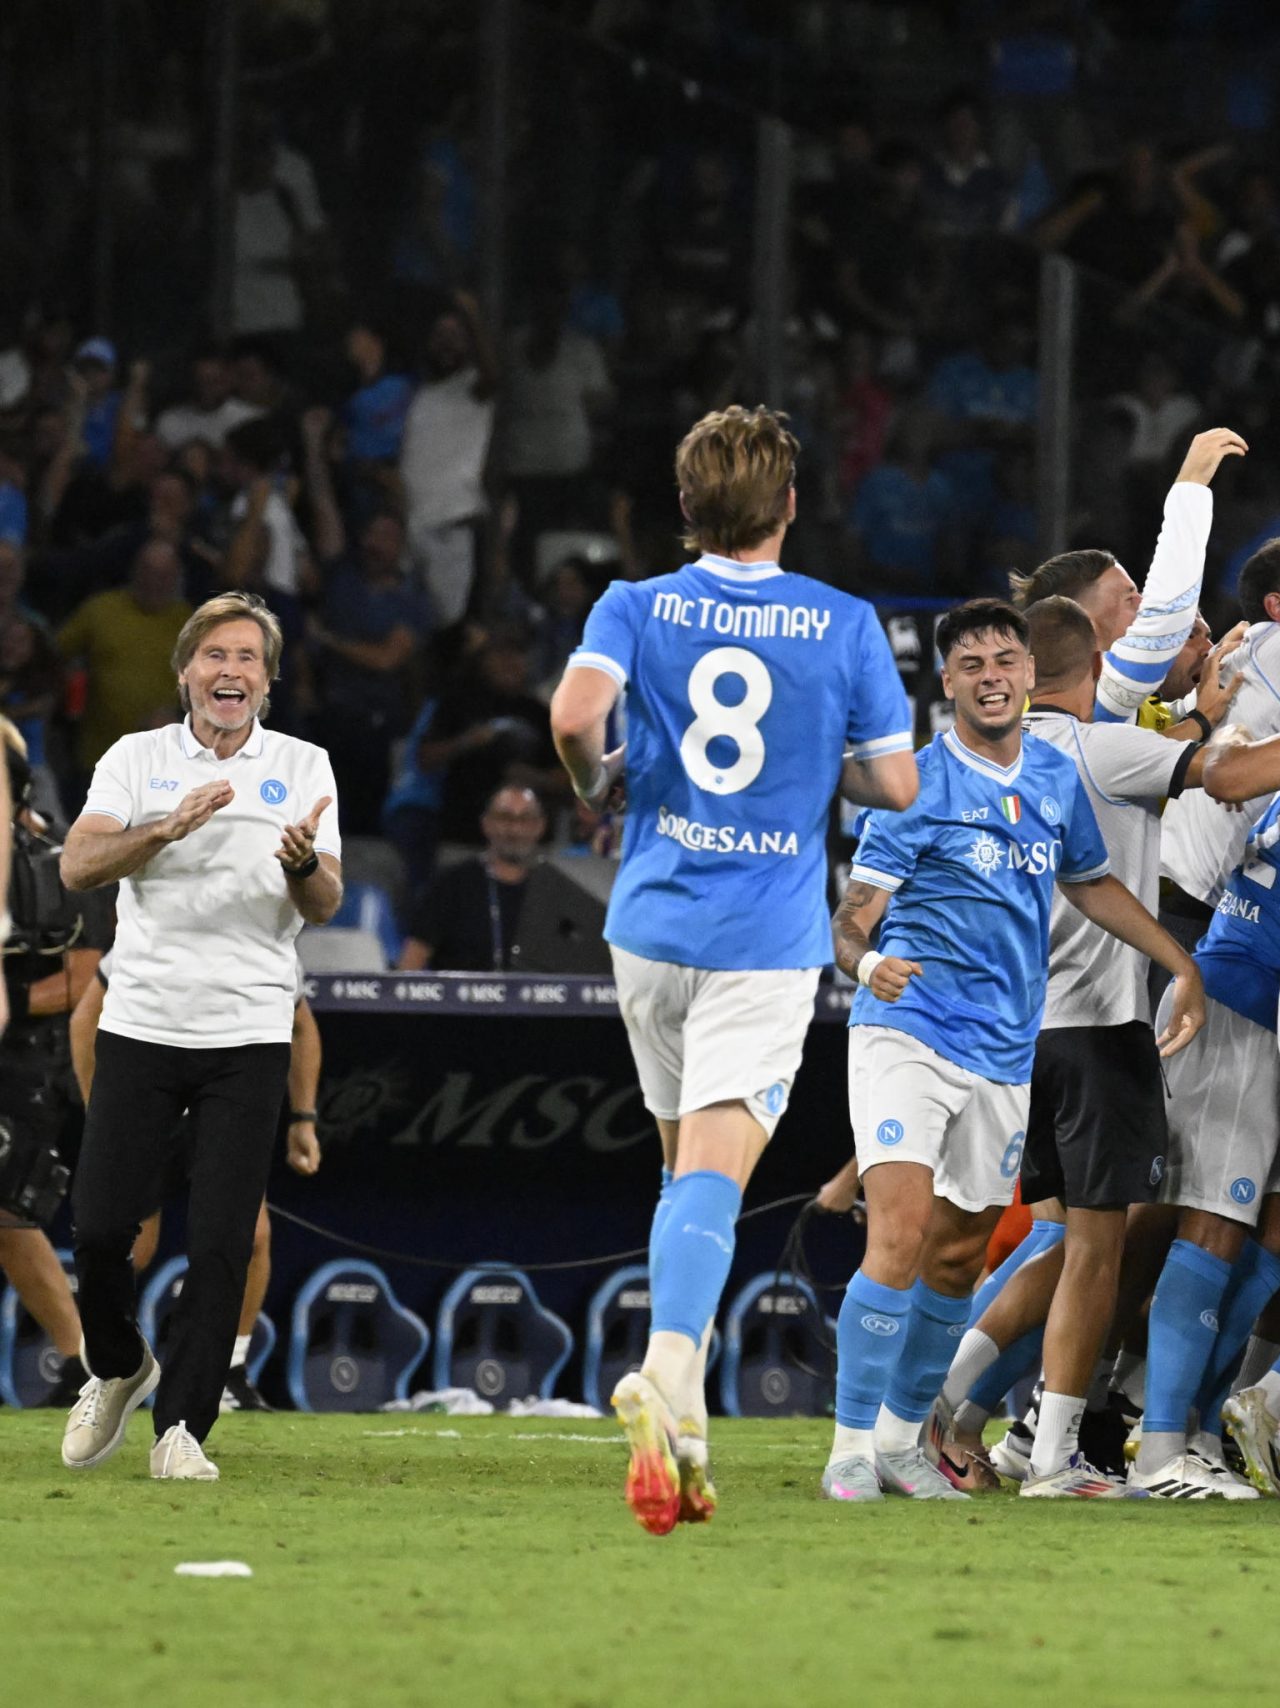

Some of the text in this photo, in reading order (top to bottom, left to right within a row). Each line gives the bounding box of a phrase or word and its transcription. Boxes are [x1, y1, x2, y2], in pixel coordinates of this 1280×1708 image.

[680, 646, 773, 795] 8
[150, 778, 179, 791] EA7
[656, 806, 799, 855] SORGESANA
[961, 807, 989, 822] EA7
[390, 1072, 656, 1152] MSC
[1000, 1130, 1025, 1178] 6
